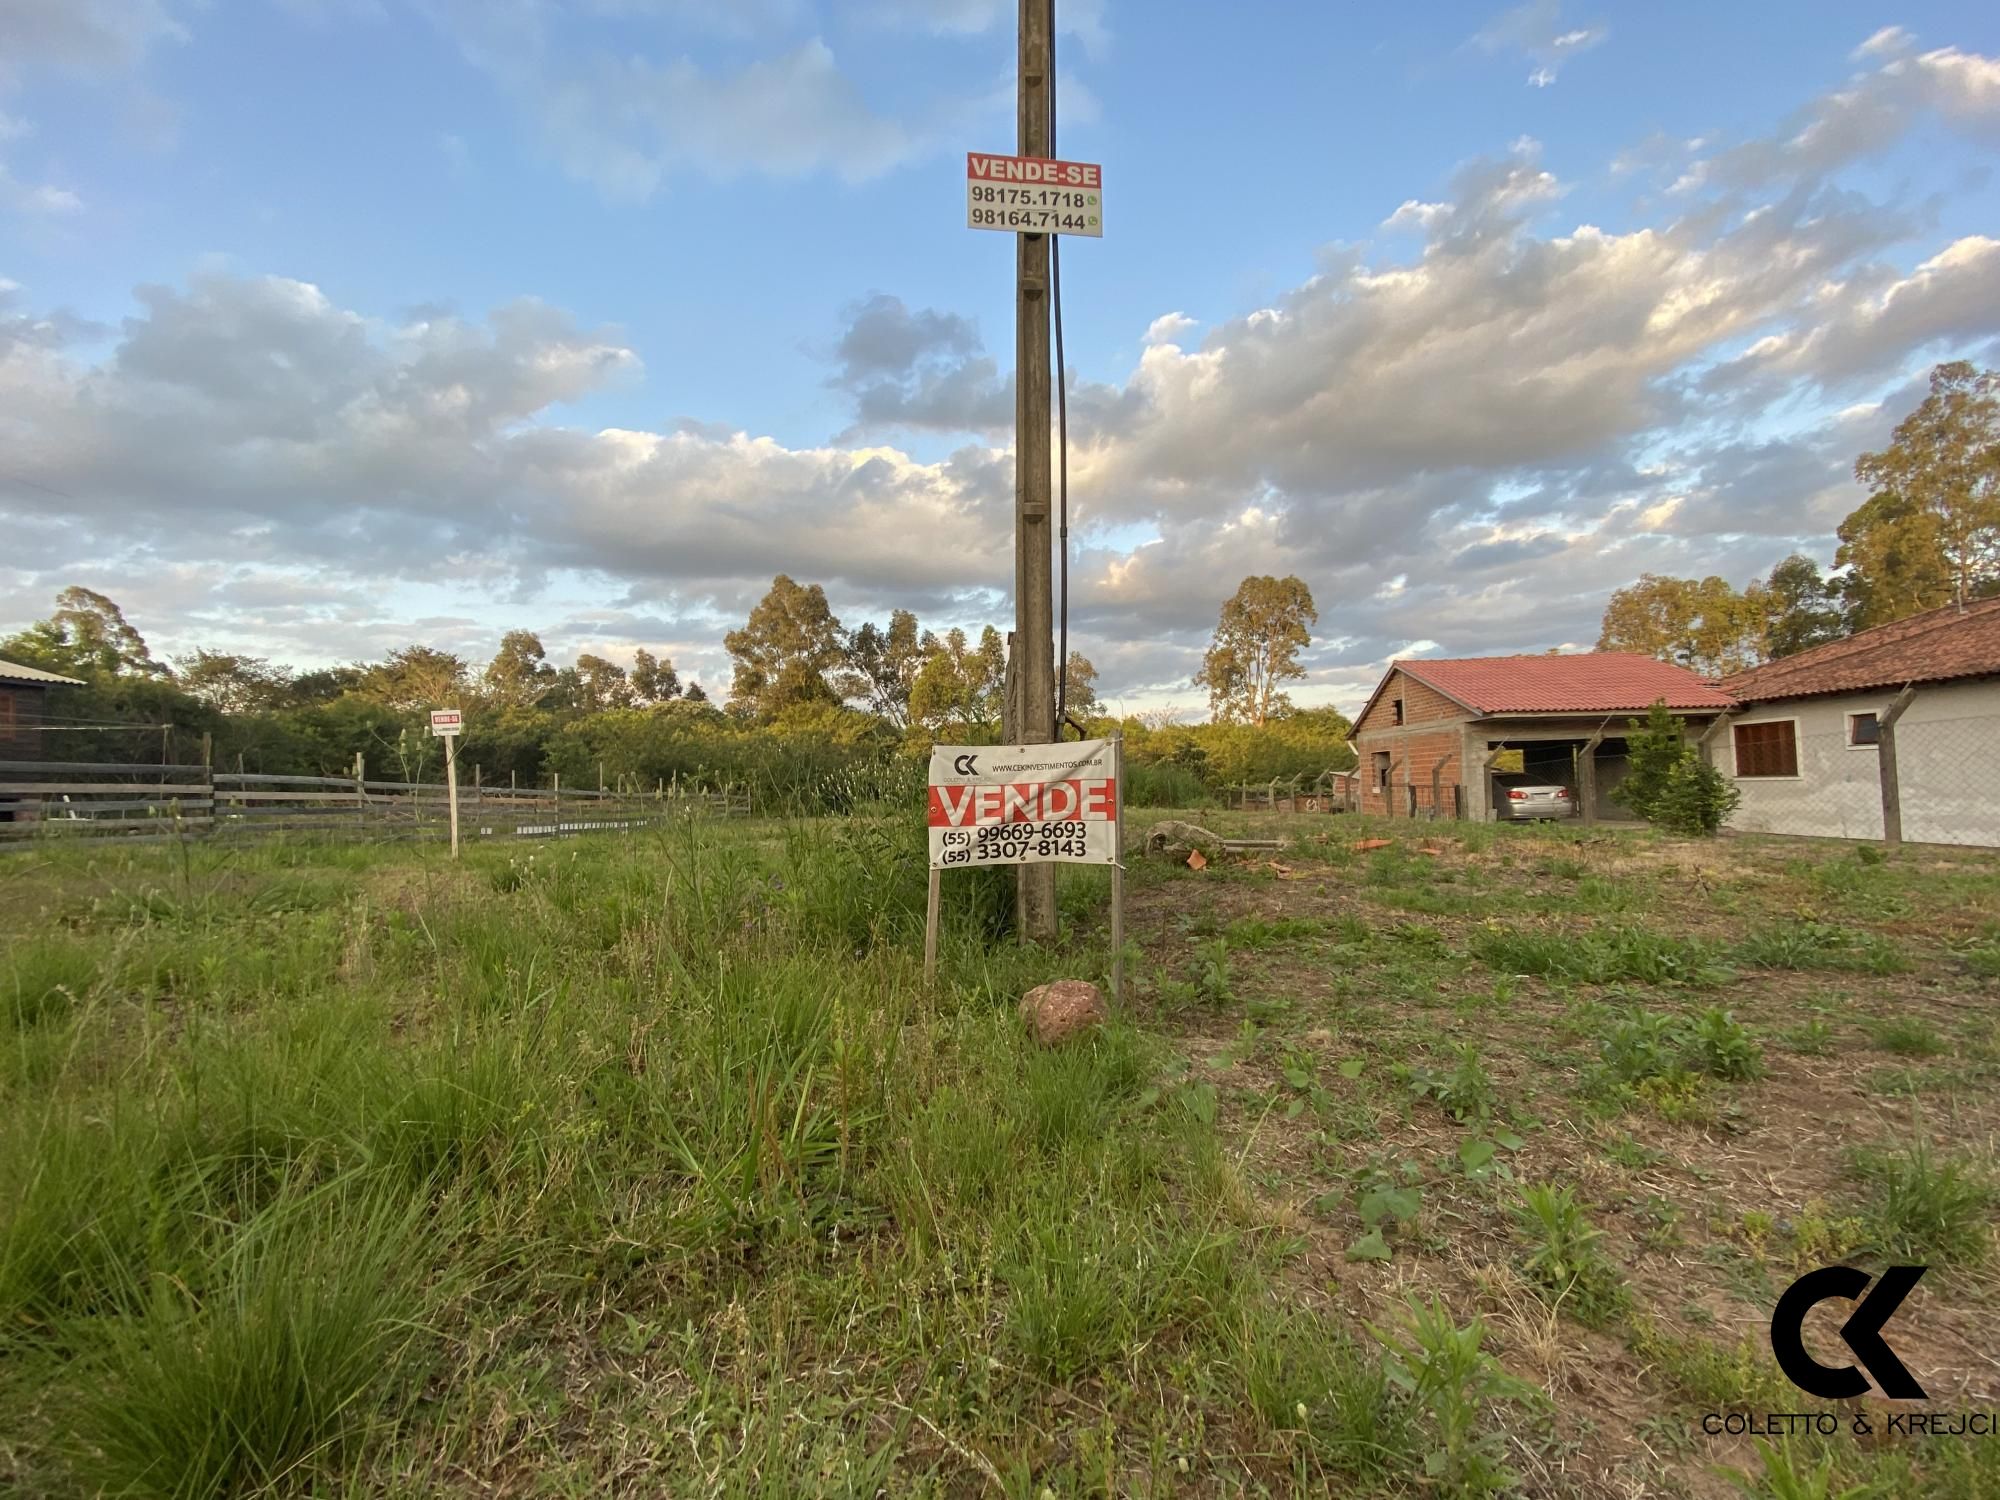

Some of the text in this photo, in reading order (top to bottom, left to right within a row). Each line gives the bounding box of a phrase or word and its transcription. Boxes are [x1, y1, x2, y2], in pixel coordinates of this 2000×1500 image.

[971, 157, 1098, 186] VENDE-SE
[972, 186, 1085, 208] 98175.1718
[972, 208, 1086, 230] 98164.7144
[936, 779, 1107, 827] VENDE
[942, 821, 1087, 847] (55) 99669-6693
[942, 839, 1087, 865] (55) 3307-8143
